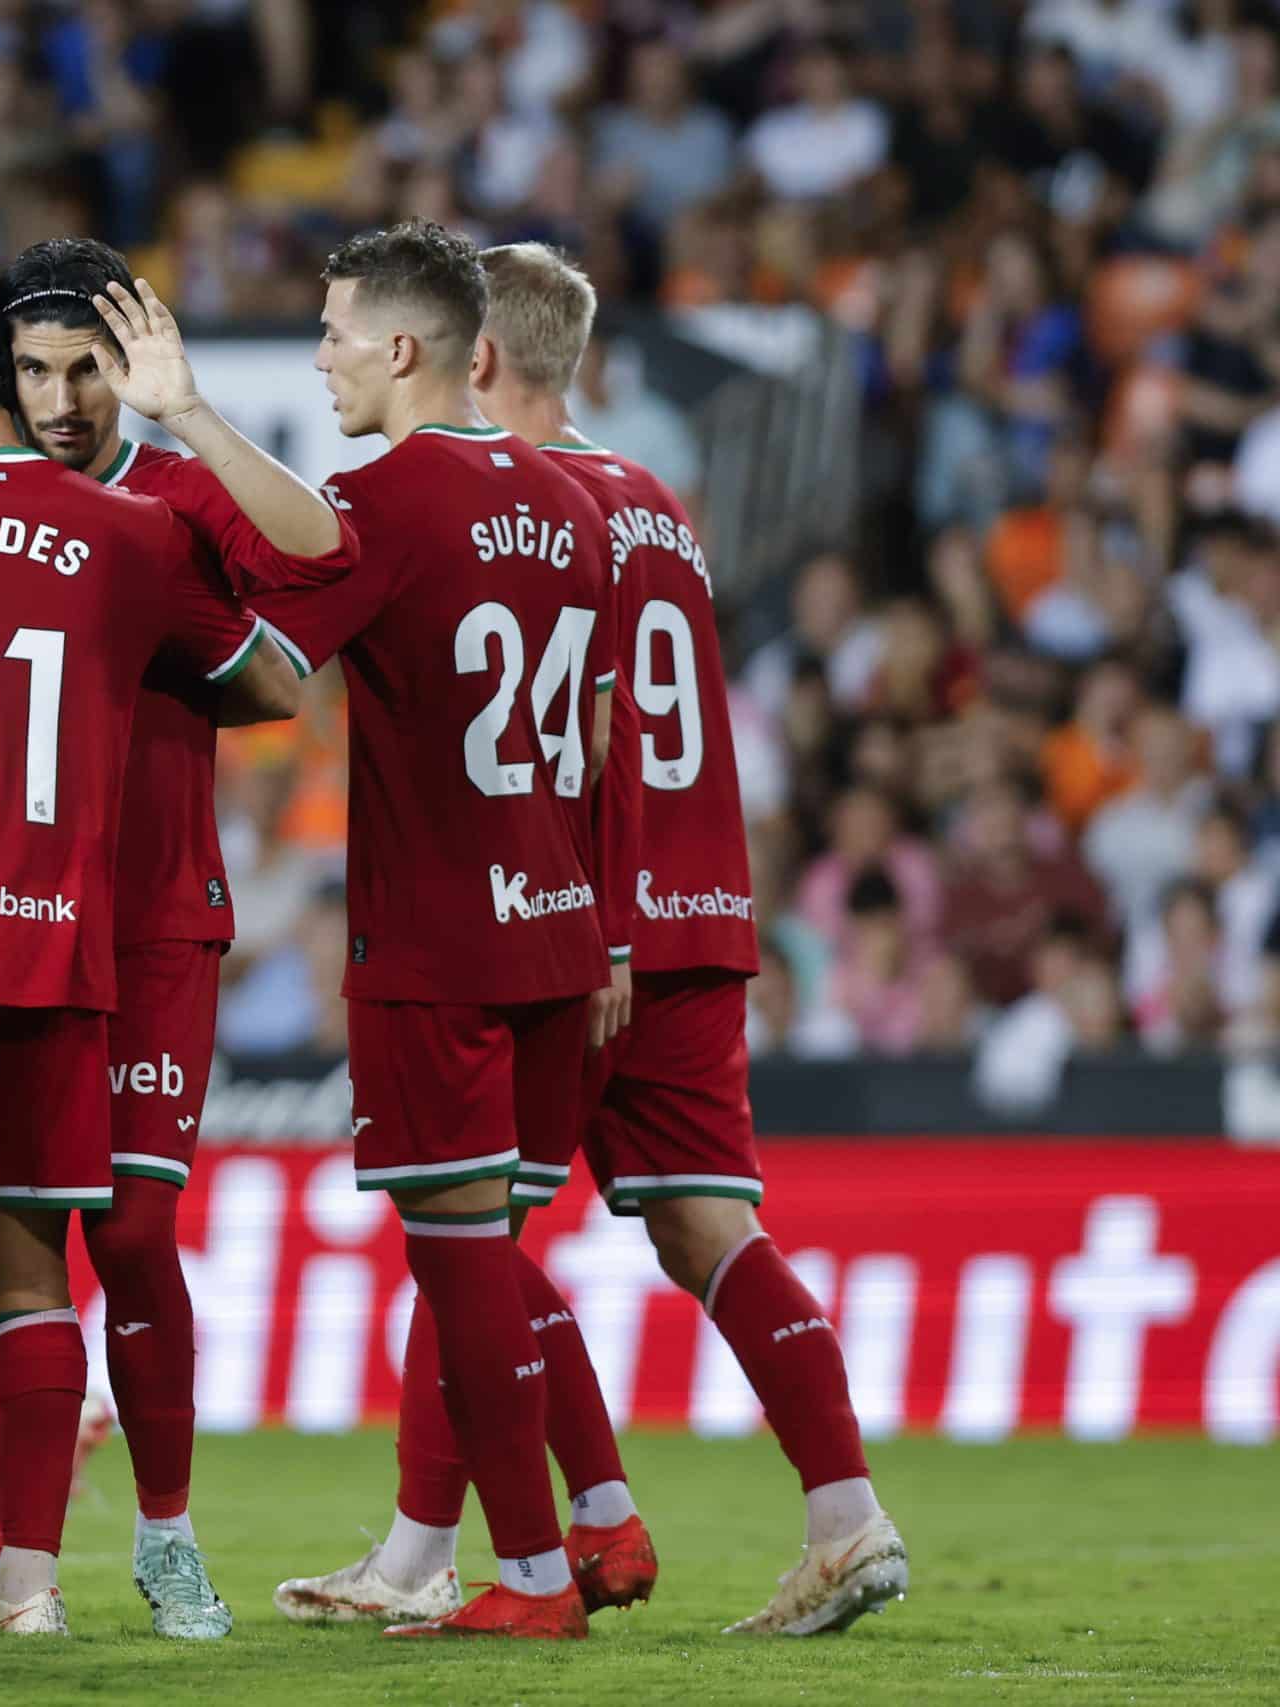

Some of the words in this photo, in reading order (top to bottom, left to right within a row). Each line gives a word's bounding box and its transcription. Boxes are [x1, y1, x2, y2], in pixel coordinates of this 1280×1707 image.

[471, 503, 574, 569] SUČIĆ
[454, 601, 597, 798] 24
[633, 599, 703, 790] 9
[772, 1316, 833, 1344] REAL
